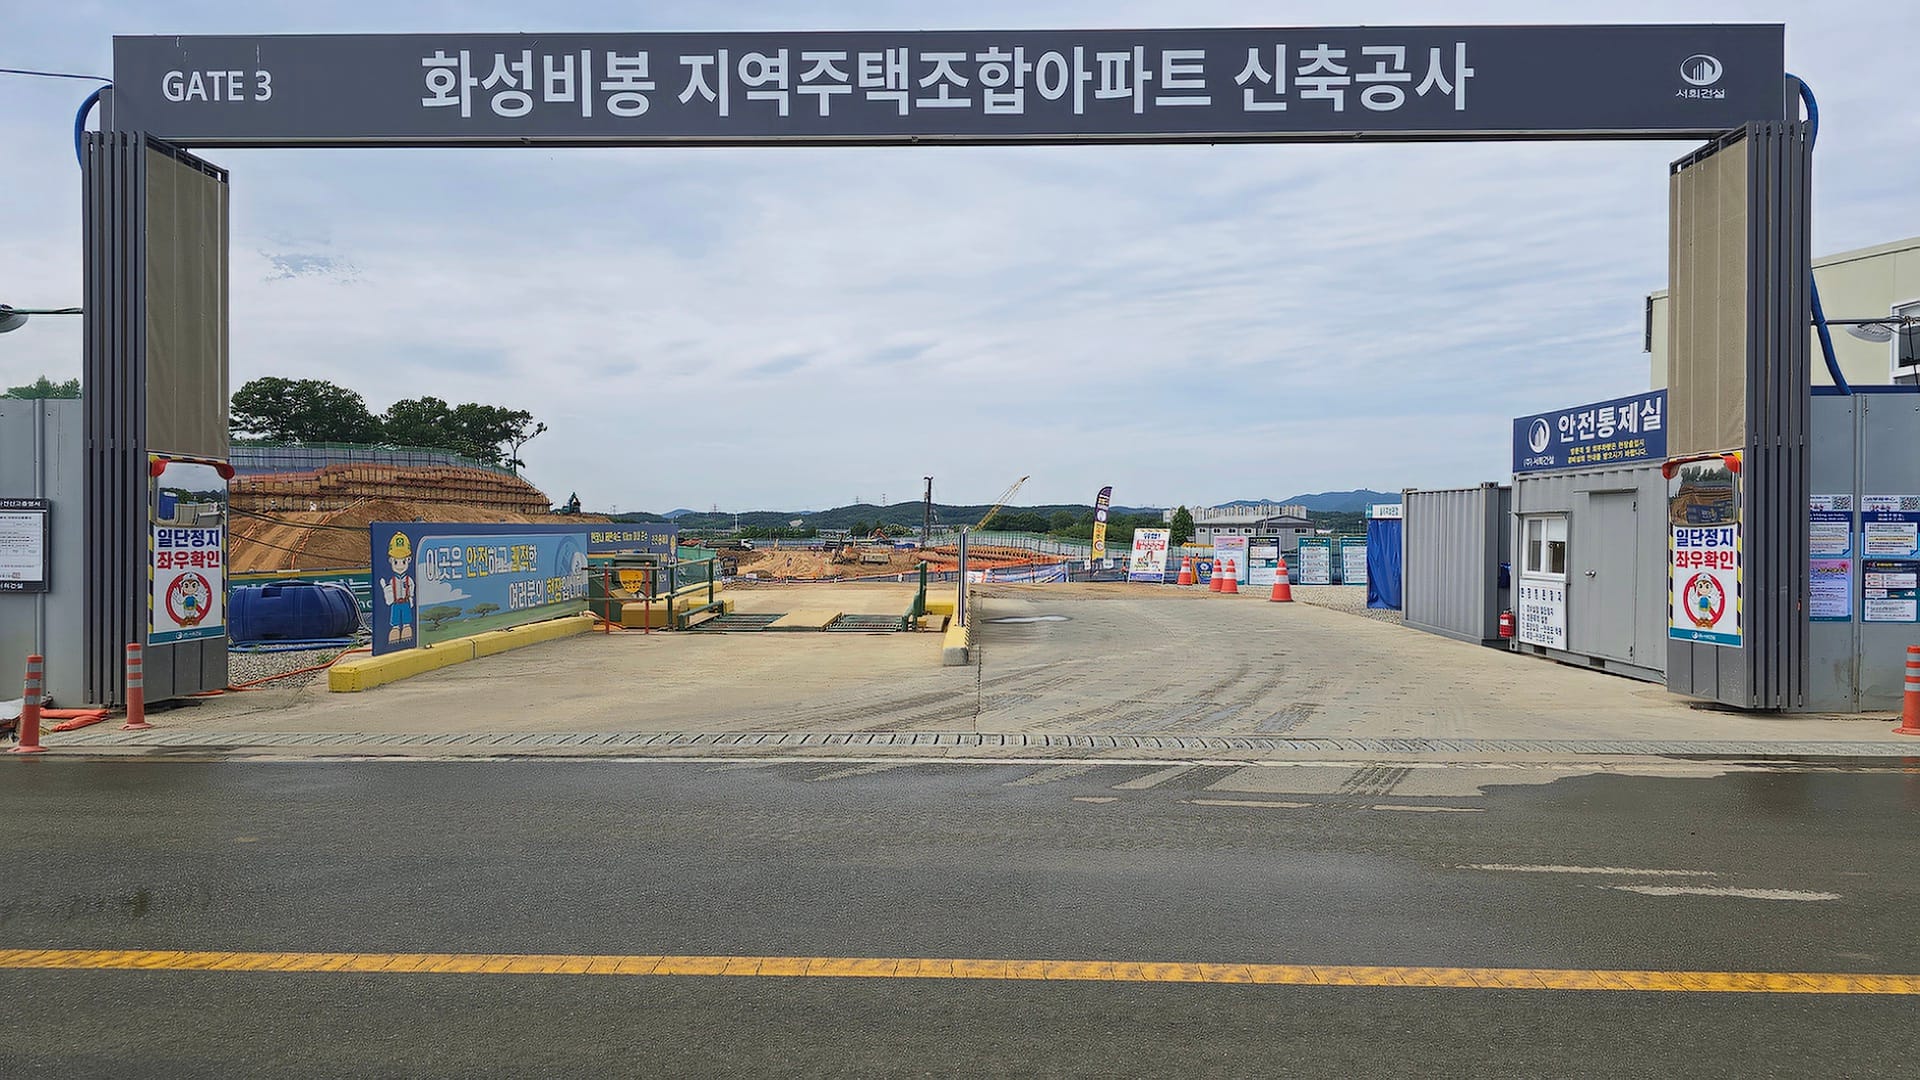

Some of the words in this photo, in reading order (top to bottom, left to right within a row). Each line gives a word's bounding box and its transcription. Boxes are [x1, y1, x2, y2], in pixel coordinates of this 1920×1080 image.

[162, 70, 244, 102] GATE
[254, 70, 272, 102] 3
[421, 49, 656, 118] 화성비봉
[677, 46, 1212, 117] 지역주택조합아파트
[1234, 42, 1475, 112] 신축공사
[1675, 88, 1725, 99] 서희건설
[1558, 397, 1662, 443] 안전통제실
[157, 529, 220, 548] 일단정지
[1676, 528, 1734, 548] 일단정지
[157, 550, 220, 570] 좌우확인
[425, 547, 463, 581] 이곳은
[466, 545, 508, 577] 안전하고
[510, 544, 537, 572] 쾌적한
[1676, 550, 1734, 571] 좌우확인
[509, 579, 544, 609] 여러분의
